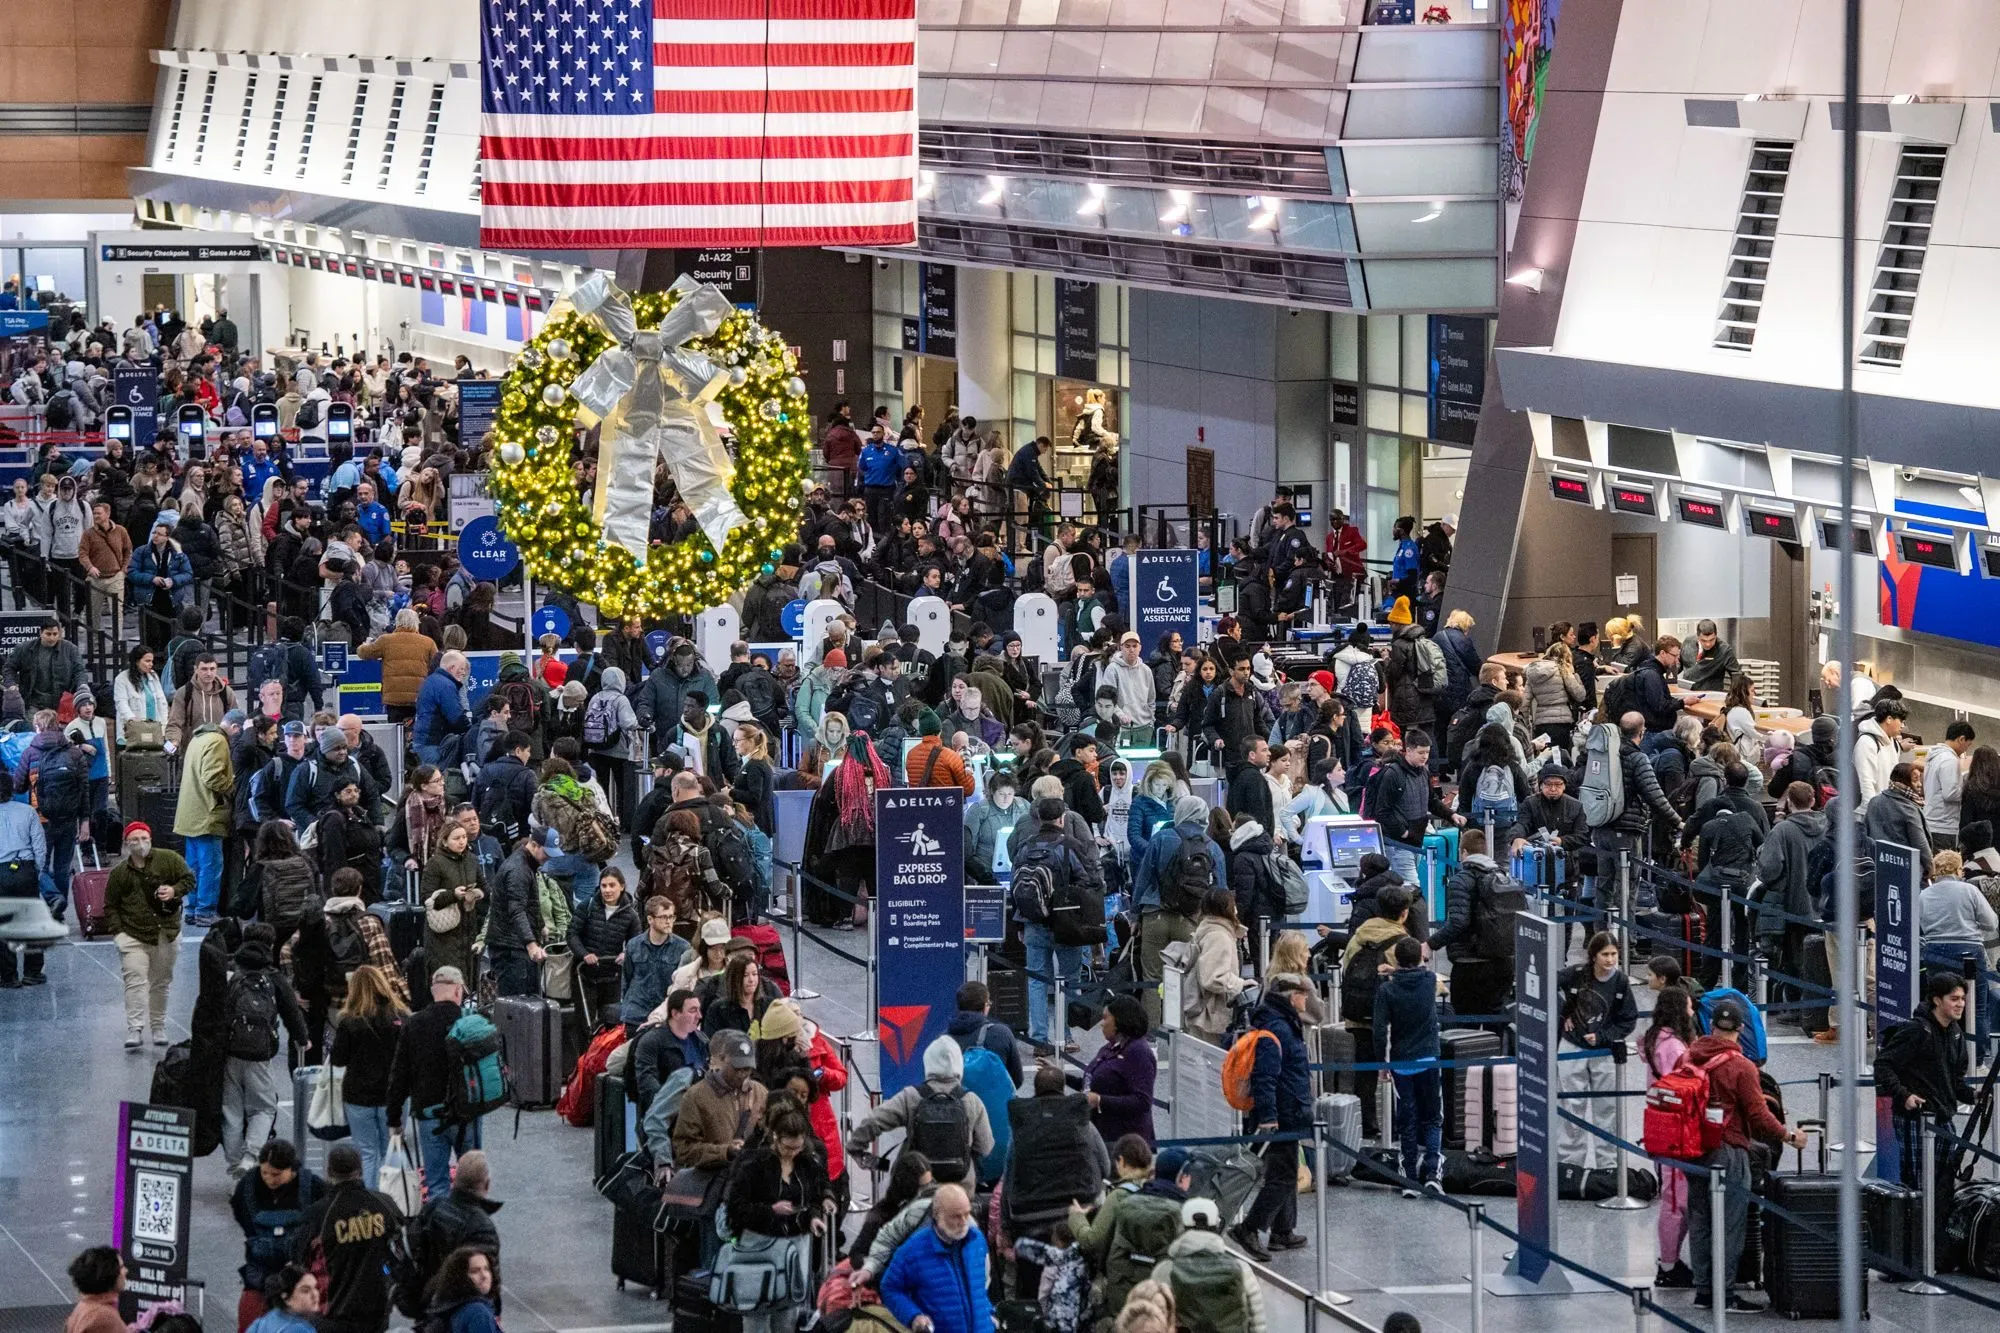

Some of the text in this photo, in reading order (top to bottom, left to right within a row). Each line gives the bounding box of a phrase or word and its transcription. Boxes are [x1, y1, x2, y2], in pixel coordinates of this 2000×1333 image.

[127, 250, 190, 258] Security Checkpoint
[698, 253, 732, 262] A1-A22
[693, 270, 732, 280] Security
[1447, 380, 1459, 392] Gates
[900, 798, 942, 807] DELTA
[1885, 853, 1904, 866] DELTA
[898, 863, 942, 873] EXPRESS
[894, 874, 947, 885] BAG DROP
[904, 942, 944, 950] Complimentary
[1887, 933, 1902, 947] KIOSK
[1882, 956, 1906, 973] BAG DROP
[147, 1137, 185, 1150] DELTA
[334, 1213, 385, 1244] CAVS
[144, 1247, 170, 1259] SCAN ME
[140, 1268, 166, 1282] WILL BE
[158, 1284, 171, 1297] OUT
